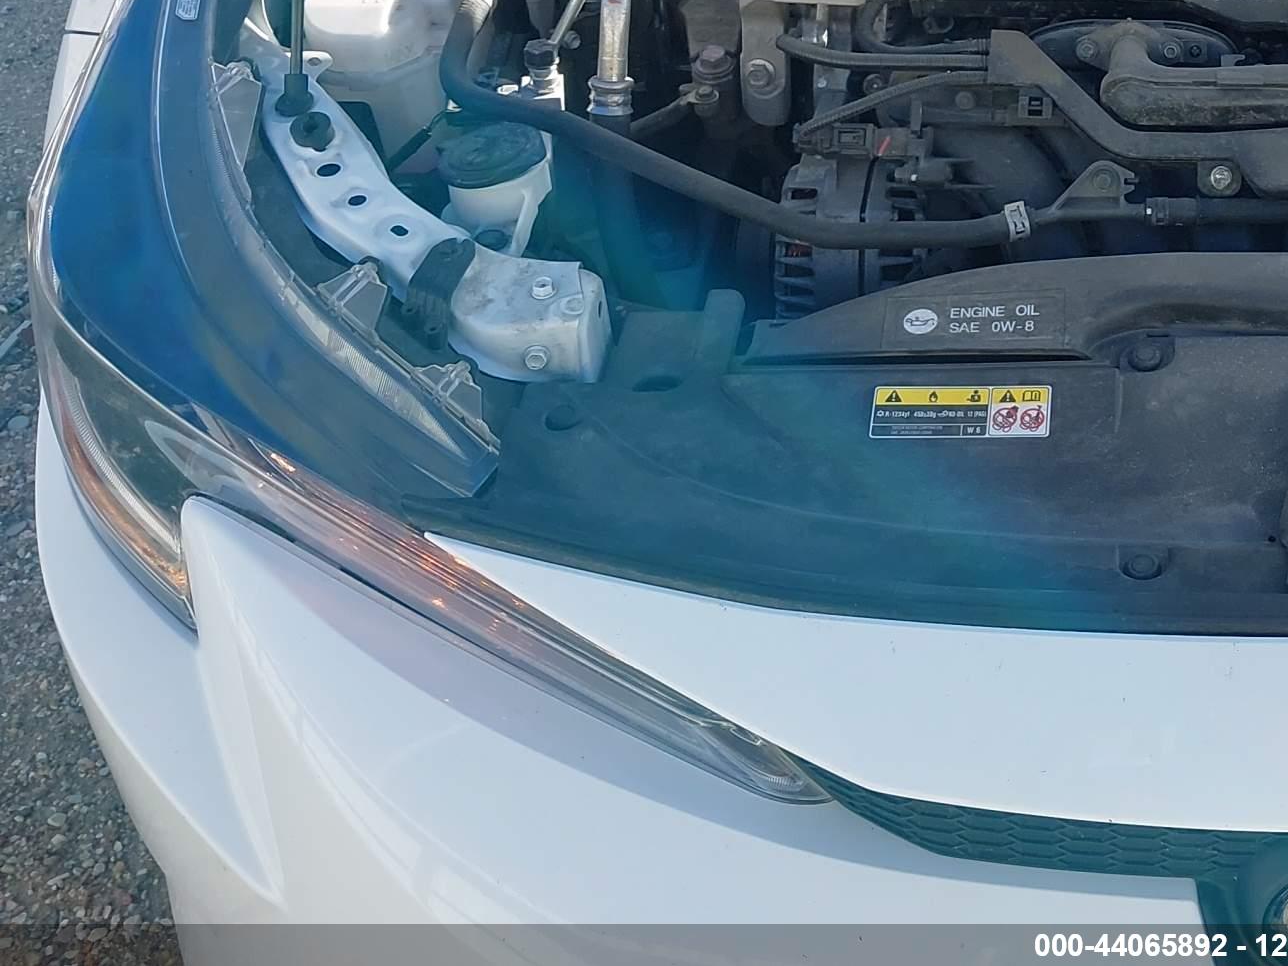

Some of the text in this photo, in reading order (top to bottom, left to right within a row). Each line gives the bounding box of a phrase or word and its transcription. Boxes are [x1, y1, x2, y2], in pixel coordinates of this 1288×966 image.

[949, 304, 1040, 319] ENGINE OIL
[949, 320, 1035, 333] SAE 0W-8
